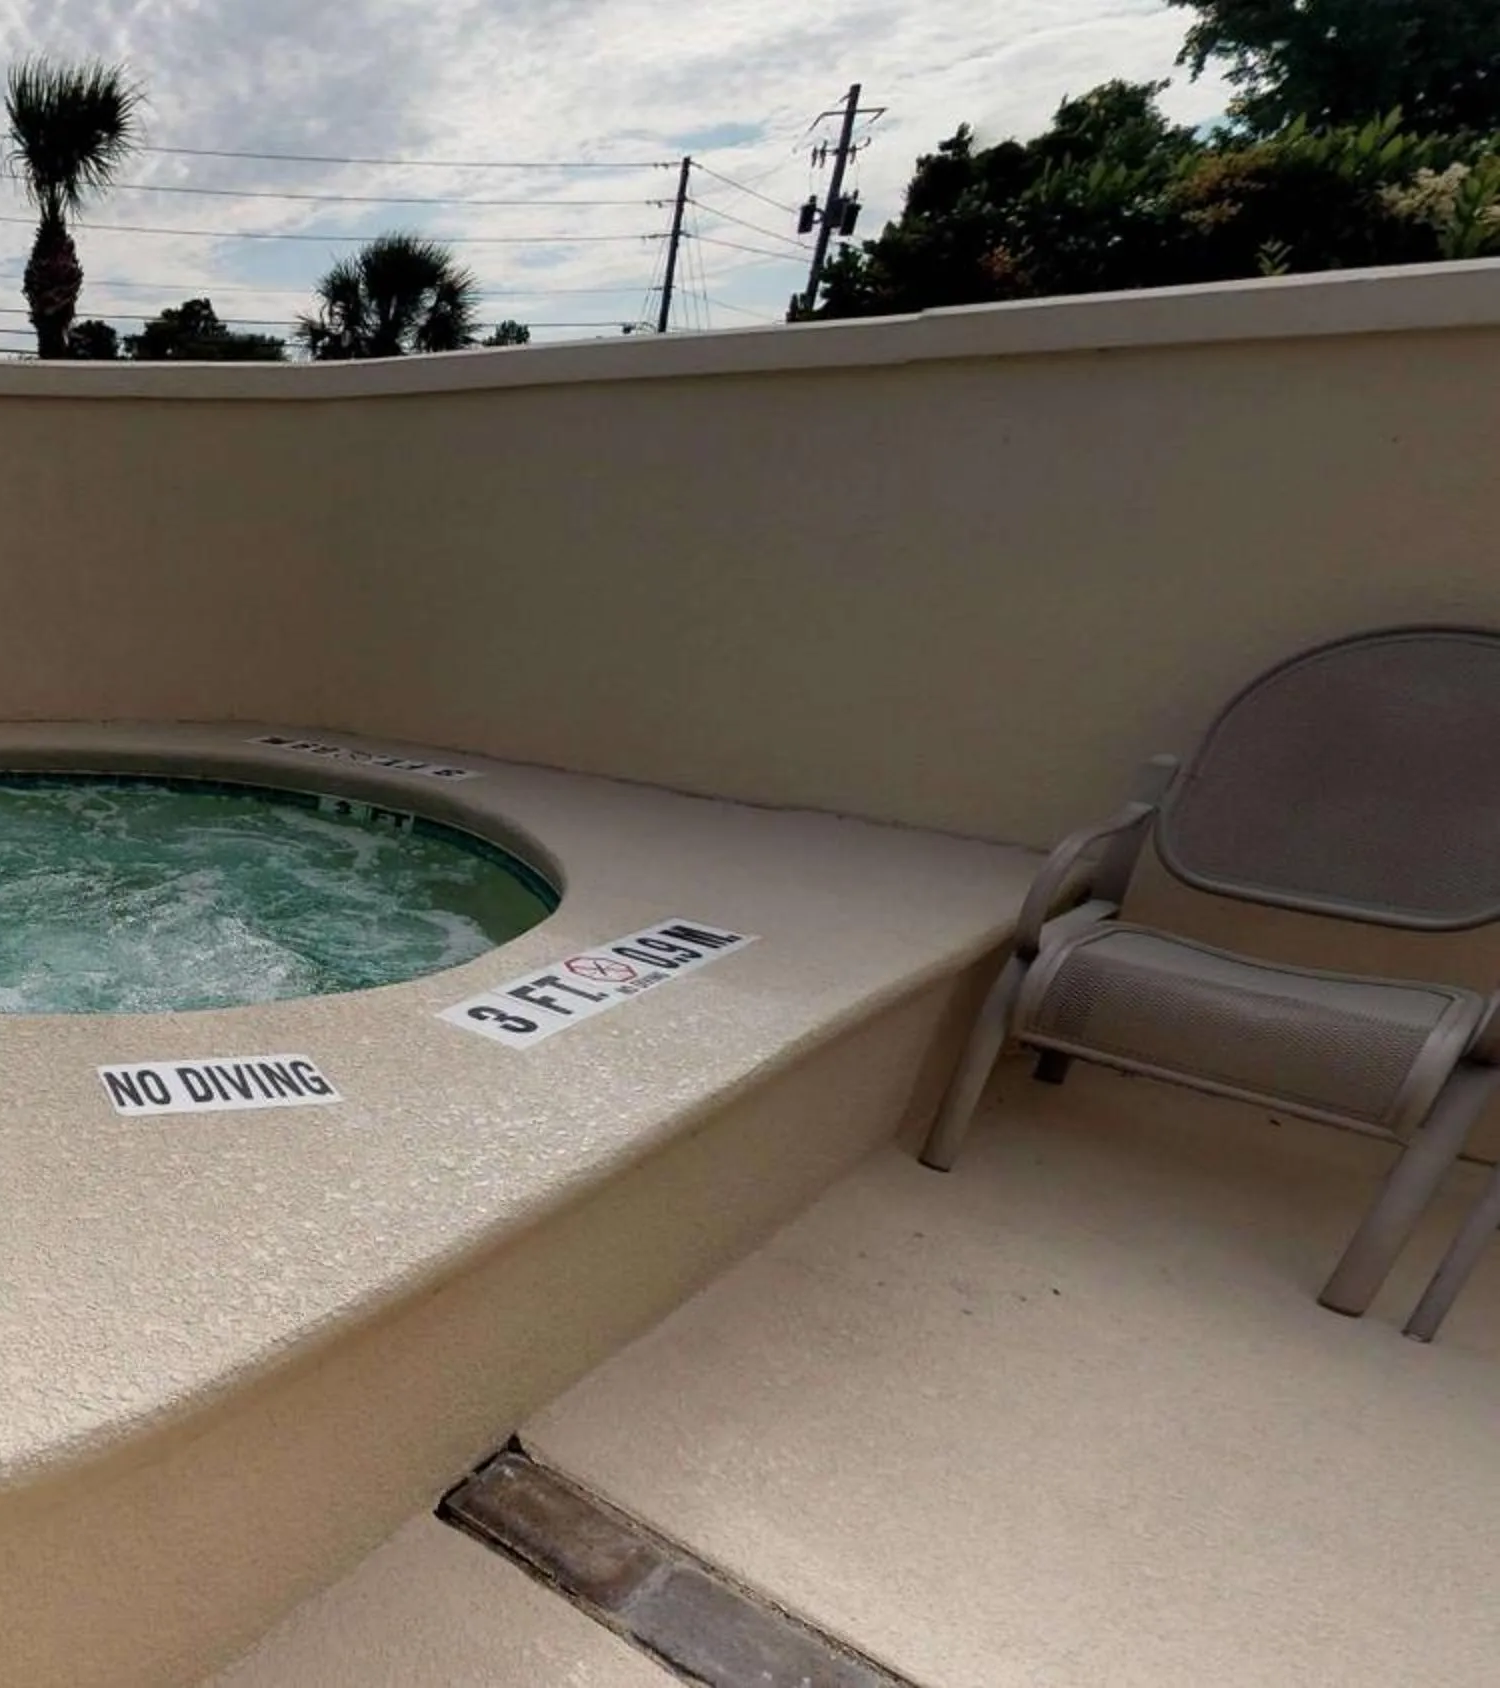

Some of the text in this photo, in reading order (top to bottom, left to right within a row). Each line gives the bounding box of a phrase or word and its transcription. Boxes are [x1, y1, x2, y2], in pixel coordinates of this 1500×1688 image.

[467, 1005, 539, 1034] 3
[103, 1060, 334, 1108] NO DIVING
